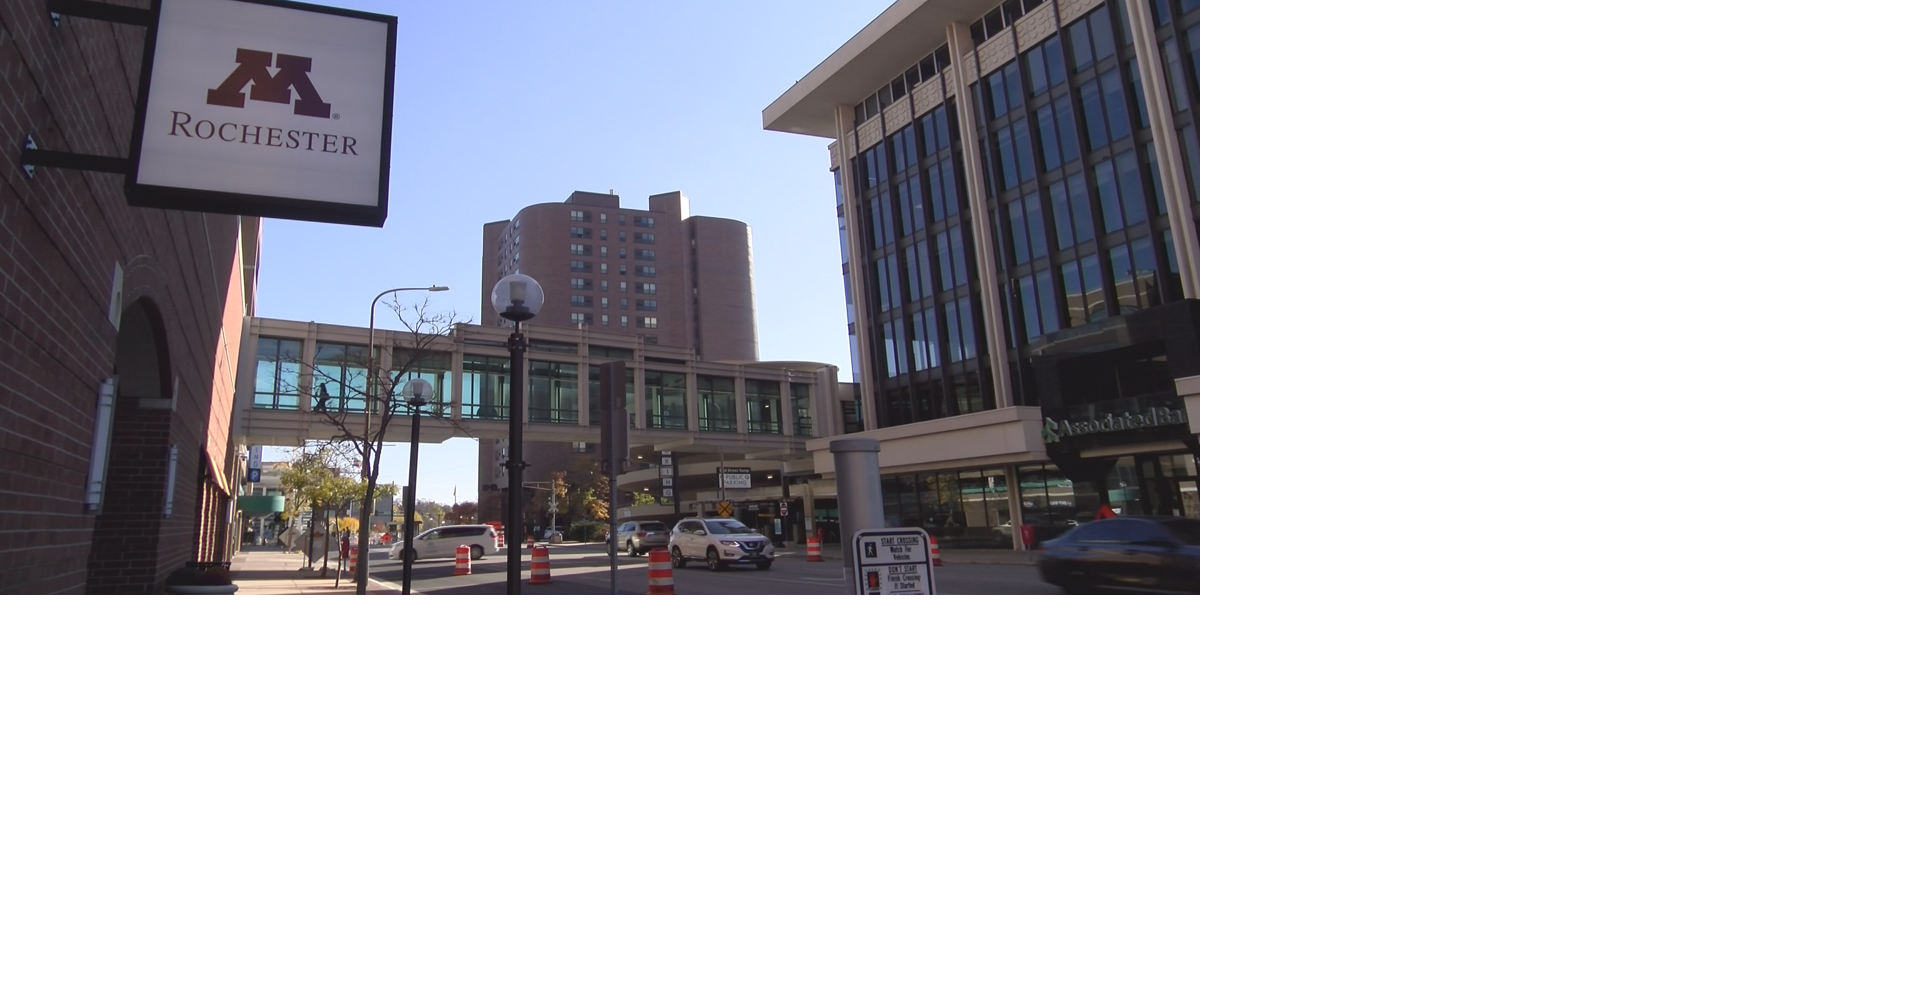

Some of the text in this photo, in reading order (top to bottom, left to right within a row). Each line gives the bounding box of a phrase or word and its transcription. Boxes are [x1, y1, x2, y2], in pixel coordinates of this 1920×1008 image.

[206, 47, 331, 119] M
[167, 110, 359, 156] ROCHESTER
[881, 536, 919, 545] START CROSSING
[902, 574, 921, 582] Crossing
